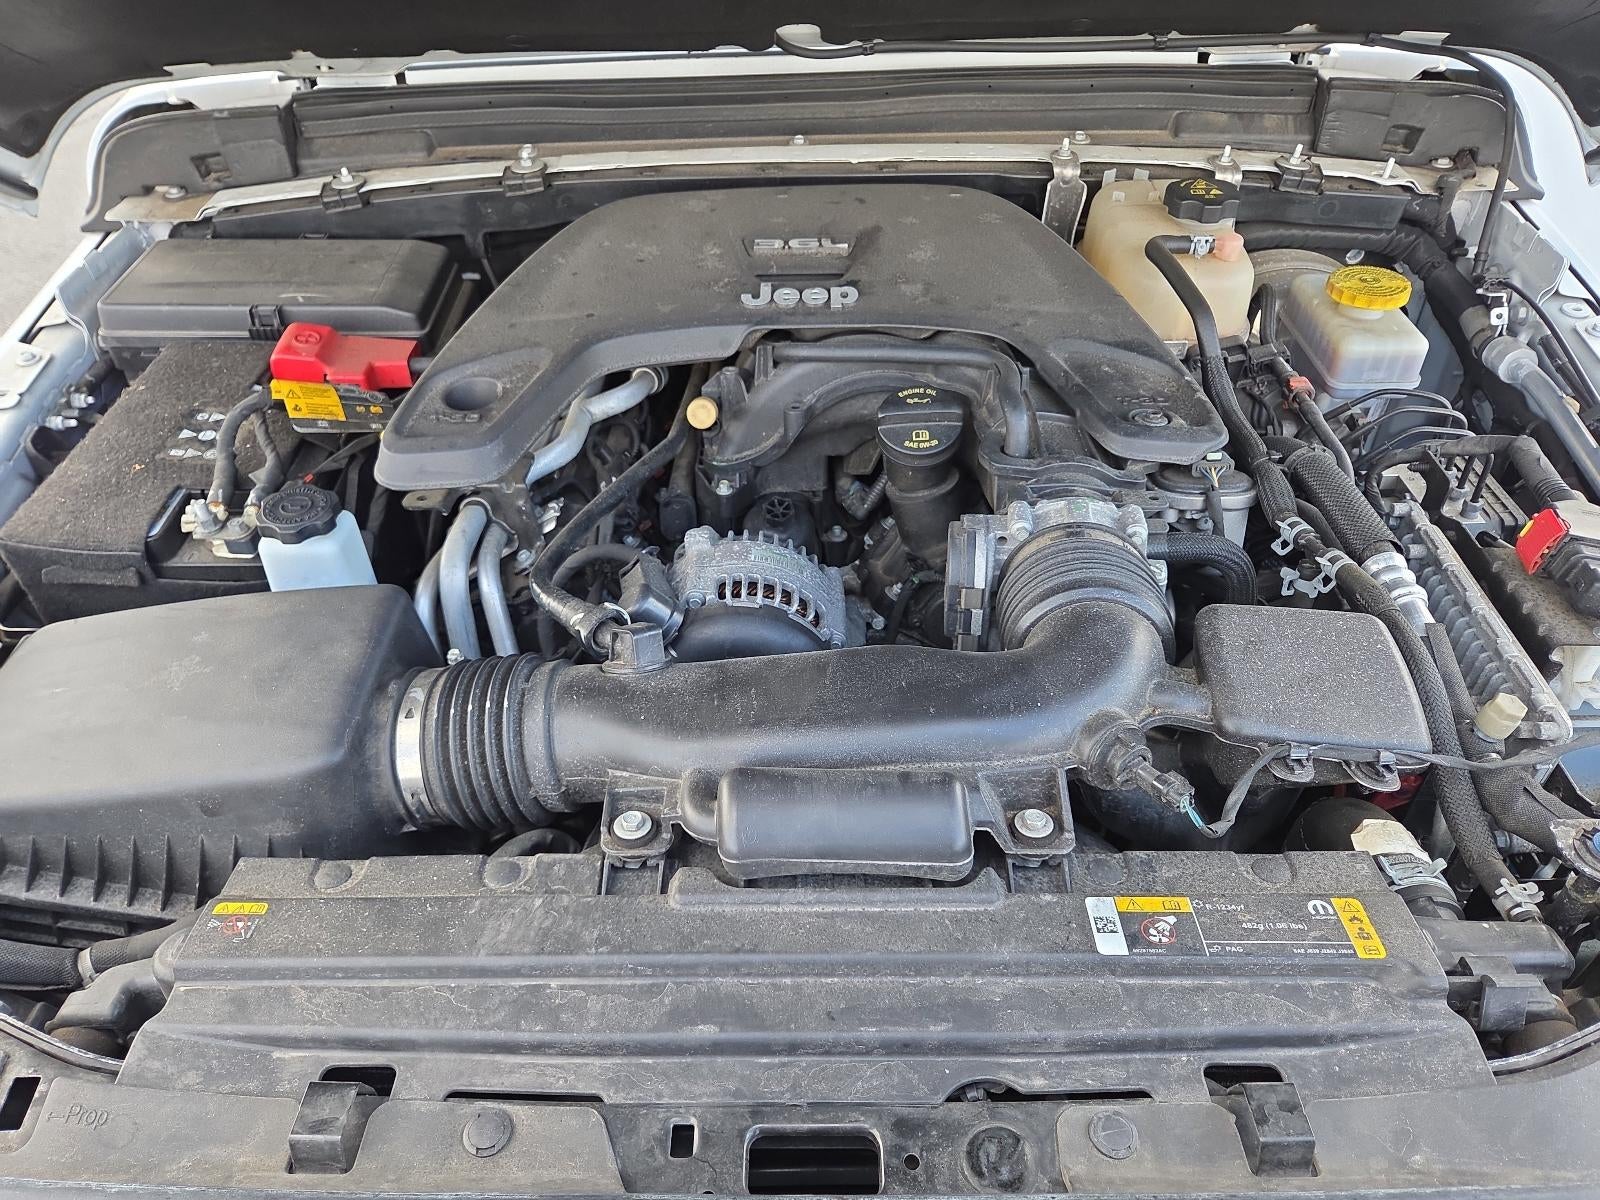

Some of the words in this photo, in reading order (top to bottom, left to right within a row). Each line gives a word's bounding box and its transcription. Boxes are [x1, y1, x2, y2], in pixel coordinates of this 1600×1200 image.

[753, 238, 849, 255] 3.6L
[740, 282, 859, 310] Jeep
[898, 388, 925, 398] ENGINE
[925, 388, 937, 396] OIL
[903, 440, 919, 449] SAE
[919, 439, 939, 449] 0W-20
[1205, 903, 1245, 912] R-1234yf
[1241, 922, 1264, 931] 482g
[63, 1103, 109, 1131] Prop
